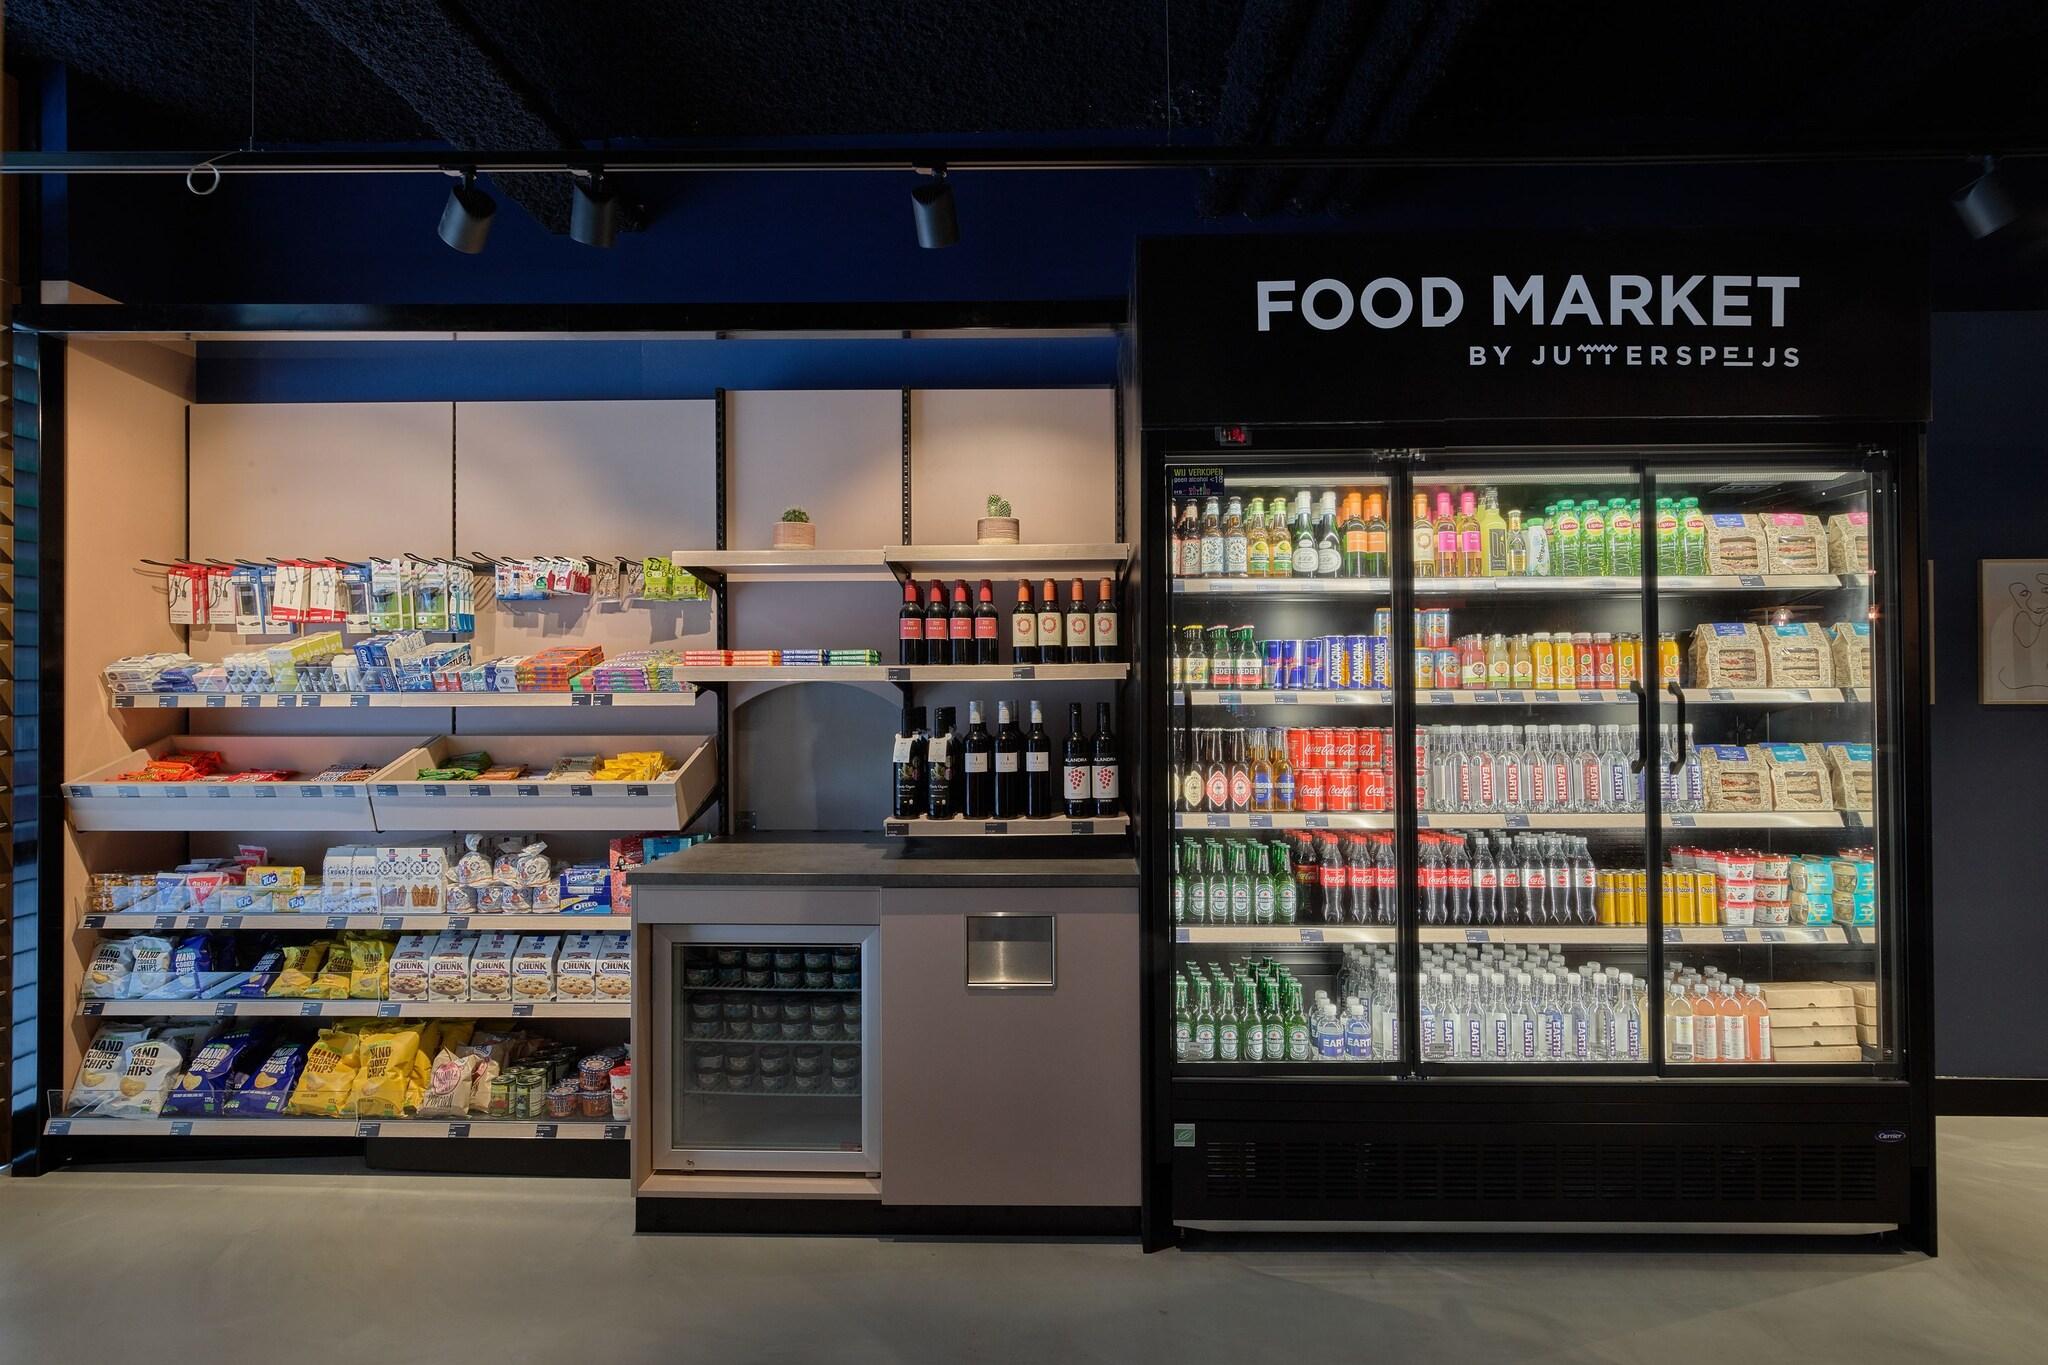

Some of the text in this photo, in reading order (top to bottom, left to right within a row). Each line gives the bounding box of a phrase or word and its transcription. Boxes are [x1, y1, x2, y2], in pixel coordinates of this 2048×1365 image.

[1257, 274, 1800, 332] FOOD MARKET
[1469, 344, 1800, 368] BY JUTTERSPEIJS
[1174, 468, 1223, 476] WIJ VERKOPEN
[1331, 643, 1341, 682] ORANGINA
[1352, 643, 1363, 682] ORANGINA
[1374, 643, 1385, 682] ORANGINA
[1482, 766, 1491, 800] EARTH
[1509, 766, 1518, 800] EARTH
[1534, 766, 1543, 800] EARTH
[1557, 766, 1567, 800] EARTH
[1590, 766, 1599, 800] EARTH
[1614, 766, 1624, 800] EARTH
[1671, 774, 1680, 800] ARTH
[263, 874, 277, 886] TUC
[237, 896, 252, 908] TUC
[289, 897, 305, 909] TUC
[573, 900, 598, 911] OREO
[137, 951, 160, 959] HAND
[176, 952, 196, 962] HAND
[93, 963, 115, 971] CHIPS
[394, 961, 424, 970] CHUNK
[434, 962, 464, 971] CHUNK
[476, 961, 505, 970] CHUNK
[518, 962, 547, 970] CHUNK
[563, 961, 591, 970] CHUNK
[601, 961, 629, 970] CHUNK
[1470, 1021, 1481, 1056] EARTH
[1496, 1021, 1506, 1056] EARTH
[1524, 1021, 1534, 1056] EARTH
[1552, 1021, 1564, 1056] EARTH
[1577, 1021, 1587, 1056] EARTH
[1629, 1021, 1639, 1056] EARTH
[91, 1040, 124, 1052] HAND
[87, 1050, 118, 1060] COOKED
[311, 1047, 342, 1064] HAND
[84, 1059, 115, 1070] CHIPS
[260, 1064, 288, 1074] CHIPS
[308, 1063, 336, 1074] CHIPS
[126, 1066, 153, 1076] HIPS
